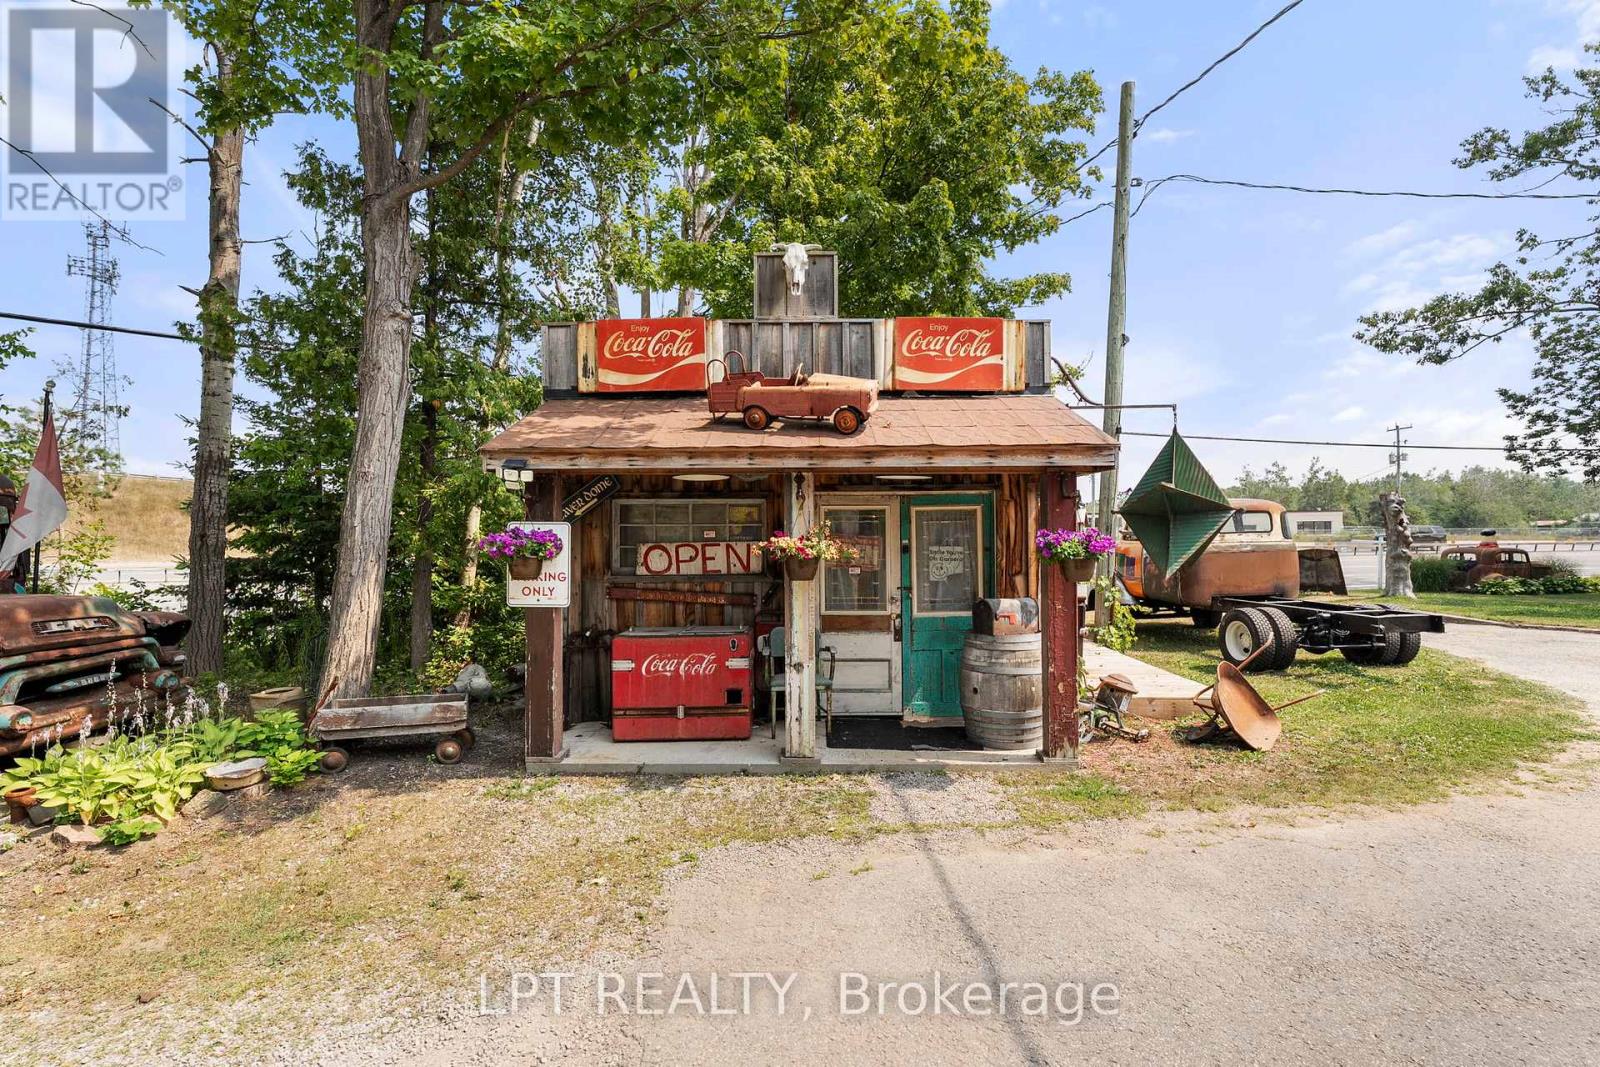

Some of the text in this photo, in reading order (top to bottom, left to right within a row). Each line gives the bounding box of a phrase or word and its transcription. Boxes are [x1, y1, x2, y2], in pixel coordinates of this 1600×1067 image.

[630, 324, 650, 333] Enjoy
[929, 323, 949, 332] Enjoy
[603, 328, 697, 359] Coca-Cola
[901, 328, 996, 357] Coca-Cola
[642, 542, 751, 576] OPEN
[521, 586, 555, 596] ONLY
